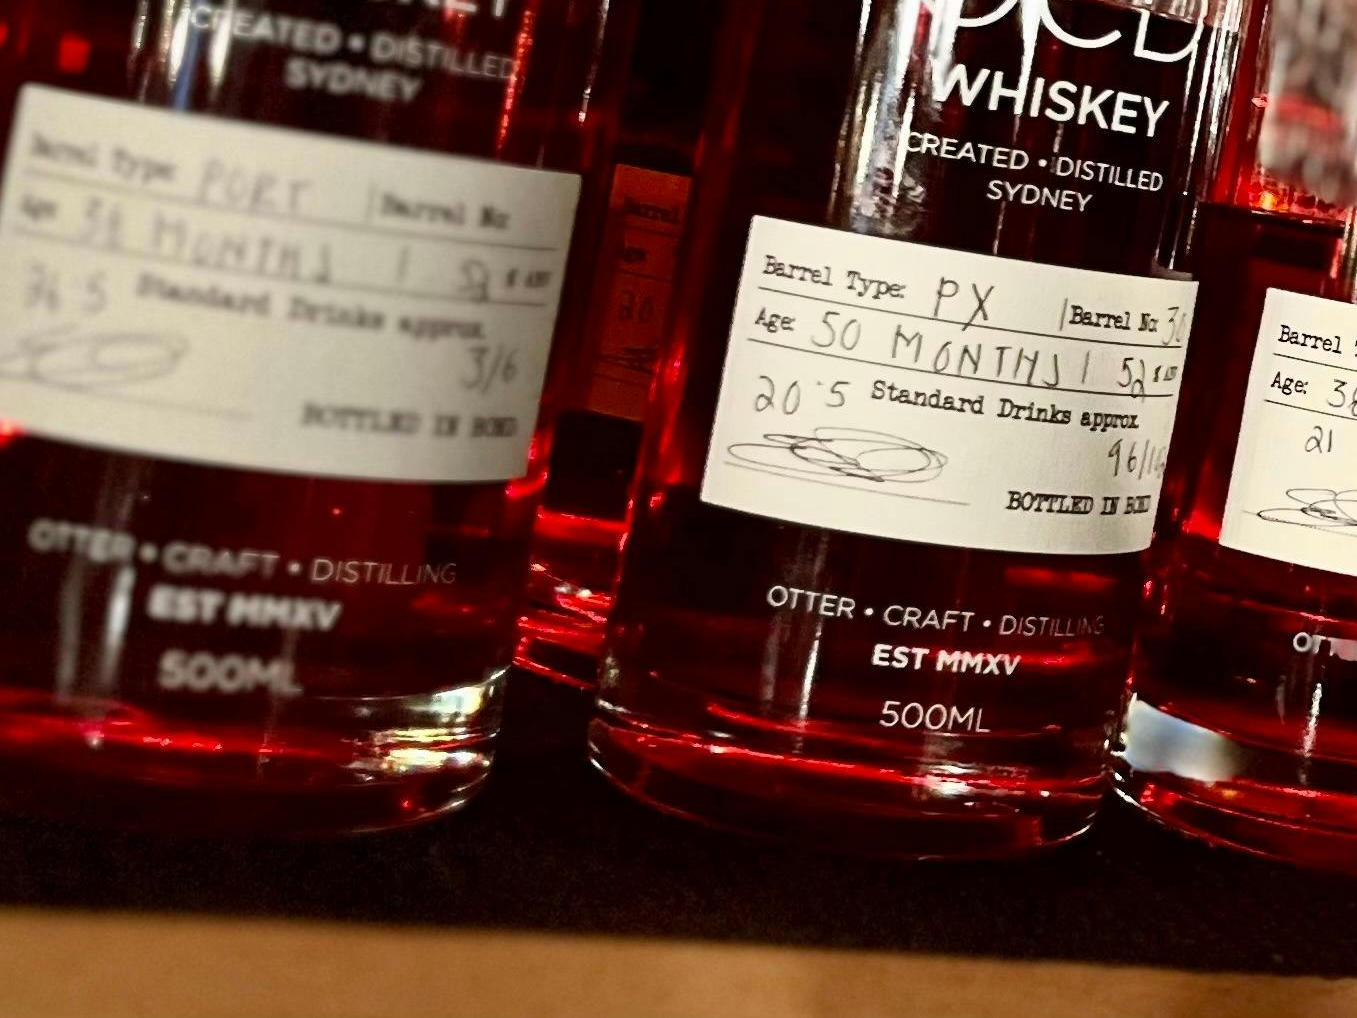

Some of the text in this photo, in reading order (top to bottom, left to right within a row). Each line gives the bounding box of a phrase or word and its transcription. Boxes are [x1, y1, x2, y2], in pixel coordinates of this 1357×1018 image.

[194, 6, 517, 80] CREATED DISTILLED
[285, 59, 422, 103] SYDNEY
[930, 61, 1170, 137] WHISKEY
[905, 131, 1164, 192] CREATED DISTILLED
[986, 180, 1093, 213] SYDNEY
[135, 269, 272, 316] Standard
[287, 295, 385, 330] Drinks
[762, 255, 833, 287] Barrel
[846, 270, 905, 299] Type:
[931, 277, 995, 332] PX
[1068, 304, 1131, 331] Barrel
[755, 307, 795, 333] Age:
[811, 311, 861, 351] 50
[892, 325, 1061, 389] MONTHS
[1278, 325, 1341, 355] Barrel
[871, 380, 985, 416] Standard
[997, 398, 1072, 424] Drinks
[1270, 371, 1307, 395] Age:
[302, 403, 421, 435] BOTTLED
[1305, 426, 1333, 453] 21
[1006, 491, 1093, 515] BOTTLED
[27, 518, 458, 585] OTTER CRAFT DISTILLING
[147, 584, 344, 632] EST MMXV
[766, 585, 1104, 637] OTTER CRAFT DISTILLING
[158, 648, 303, 695] 500ML
[871, 643, 1022, 676] EST MMXV
[879, 700, 992, 733] 500ML
